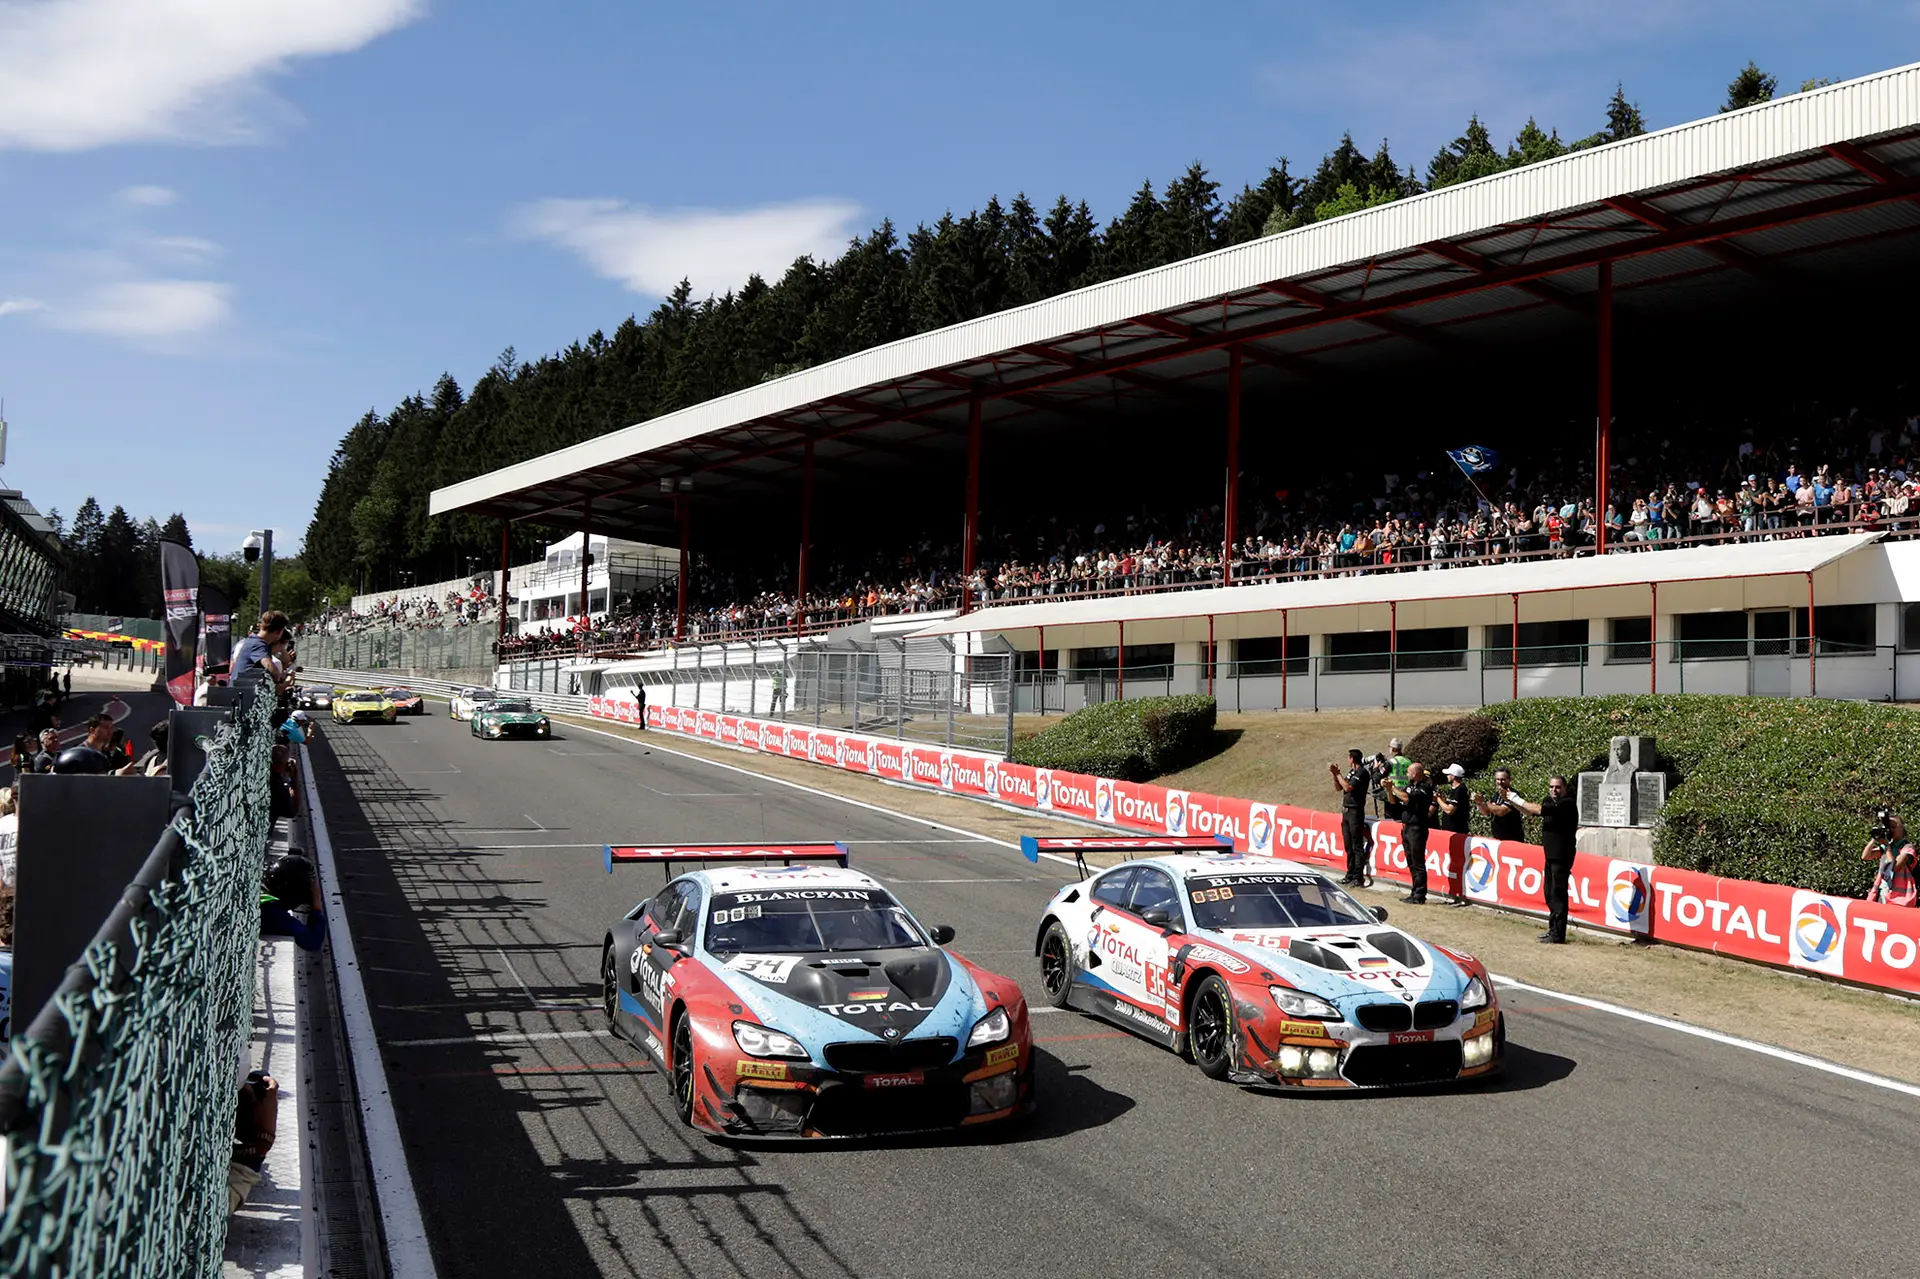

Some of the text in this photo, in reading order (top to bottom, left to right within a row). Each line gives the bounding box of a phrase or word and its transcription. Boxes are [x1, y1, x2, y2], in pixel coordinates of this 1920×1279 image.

[743, 725, 758, 742] TOTAL
[765, 730, 783, 747] TOTAL
[789, 734, 808, 753] TOTAL
[815, 739, 836, 759] TOTAL
[844, 745, 867, 765] TOTAL
[877, 750, 901, 771] TOTAL
[912, 755, 940, 779] TOTAL
[953, 761, 984, 787] TOTAL
[999, 771, 1035, 797] TOTAL
[1052, 780, 1095, 810] TOTAL
[1114, 792, 1164, 823] TOTAL
[1188, 804, 1246, 839] TOTAL
[1276, 817, 1344, 856] TOTAL
[1379, 834, 1457, 879] TOAL
[1208, 876, 1318, 888] BLANCPAIN
[1502, 856, 1600, 908] TOAL
[734, 890, 870, 904] BLANCPAIN
[1655, 881, 1781, 945] TOTAL
[1102, 929, 1142, 967] TOTAL
[1243, 935, 1280, 948] 36
[640, 951, 661, 996] TOTAL
[737, 958, 786, 974] 34
[1341, 970, 1431, 981] TOTAL
[1148, 962, 1166, 999] 36
[818, 1002, 934, 1017] TOTAL
[1114, 999, 1133, 1016] BMW
[1395, 1034, 1429, 1043] TOTAL
[872, 1076, 916, 1088] TOTAL
